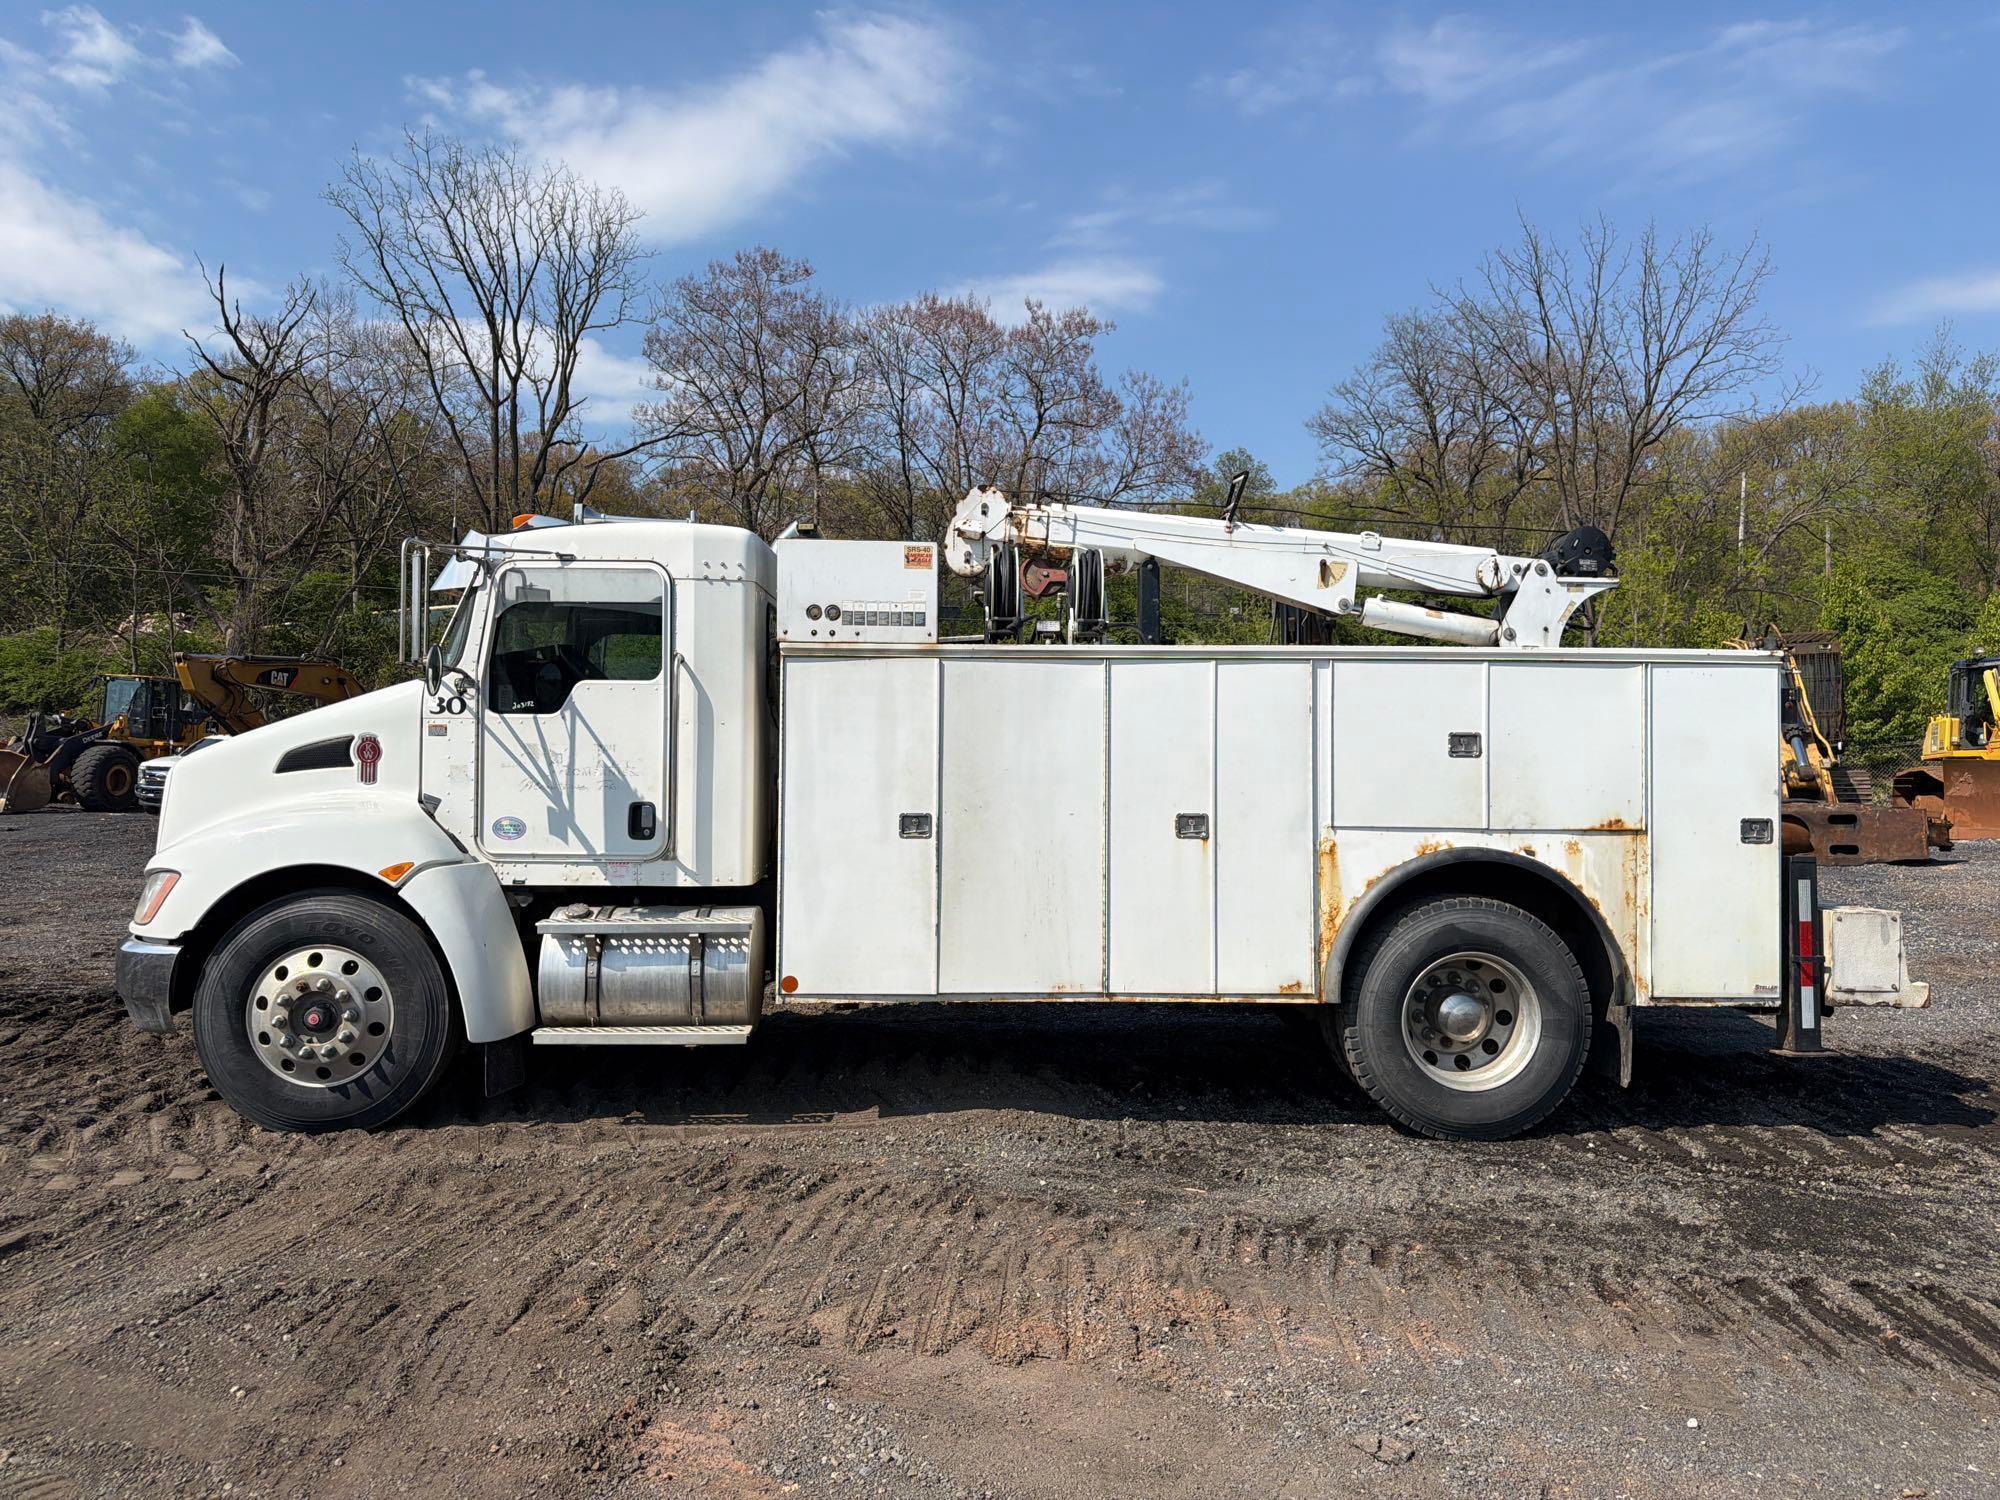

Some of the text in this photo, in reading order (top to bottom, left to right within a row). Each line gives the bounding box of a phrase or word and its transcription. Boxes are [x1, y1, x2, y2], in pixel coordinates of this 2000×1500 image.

[271, 670, 289, 687] CAT
[429, 696, 467, 715] 30
[82, 731, 103, 743] DEERE
